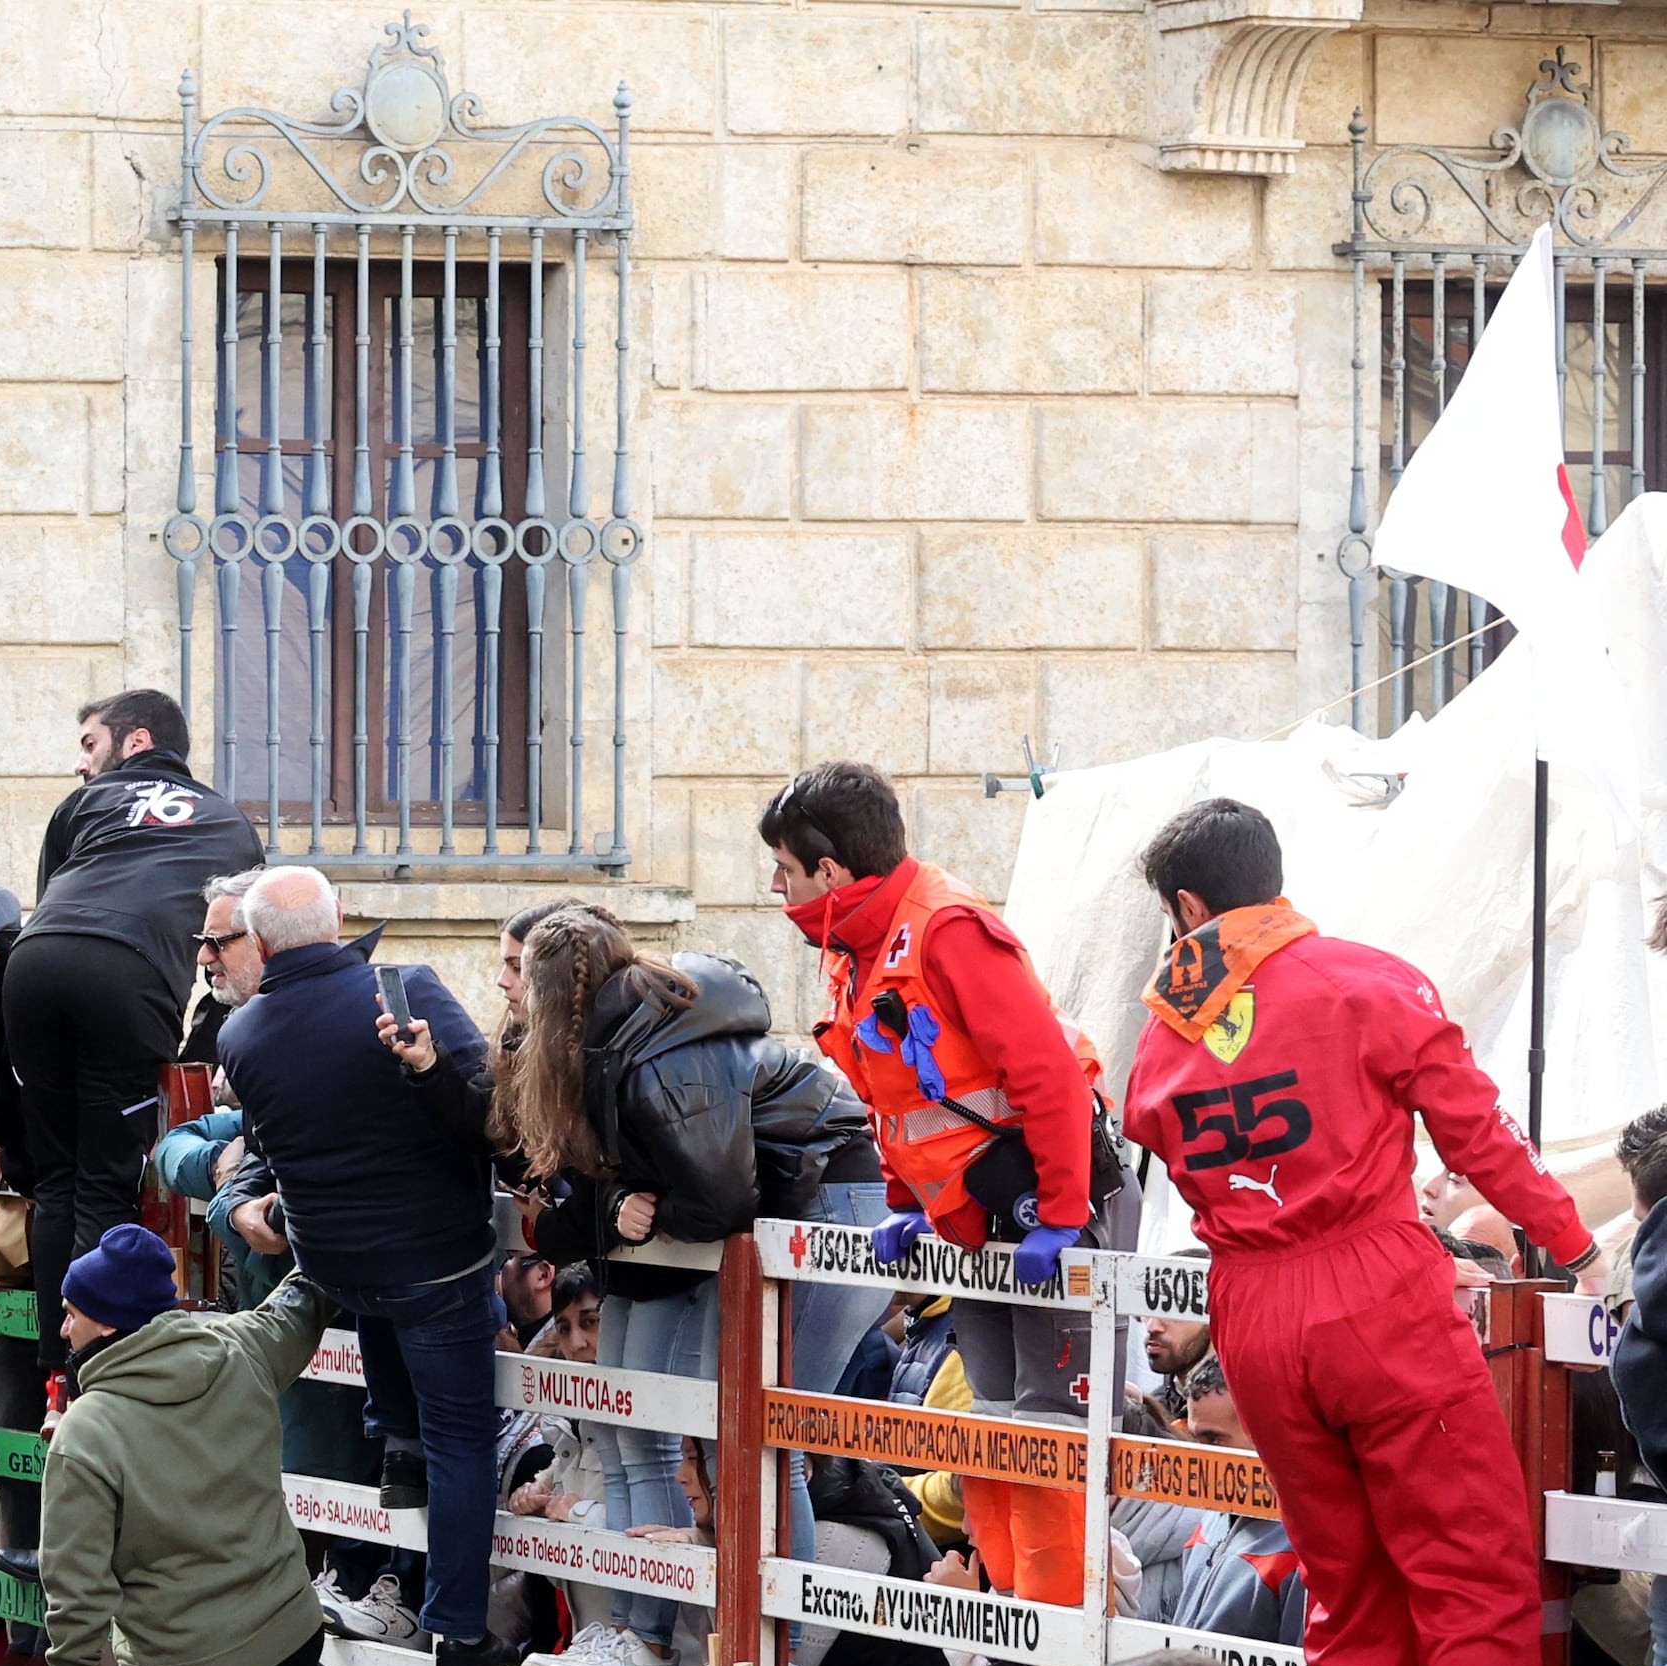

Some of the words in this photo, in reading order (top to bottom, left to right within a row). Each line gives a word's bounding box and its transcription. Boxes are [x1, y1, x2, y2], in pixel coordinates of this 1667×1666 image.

[1171, 1069, 1313, 1172] 55
[810, 1229, 849, 1272] USO
[958, 1251, 1011, 1294] CRUZ
[1144, 1265, 1189, 1314] USO
[1191, 1270, 1210, 1316] E
[538, 1370, 633, 1417] MULTICIA.es
[8, 1440, 45, 1477] GES
[768, 1402, 841, 1448] PROHIBIDA
[844, 1411, 861, 1451] LA
[865, 1415, 970, 1466] PARTICIPACIÓN
[972, 1429, 984, 1468] A
[987, 1430, 1058, 1479] MENORES
[1066, 1442, 1087, 1483] DE
[1117, 1448, 1133, 1489] 18
[1187, 1457, 1209, 1500] EN
[1213, 1462, 1247, 1505] LOS
[1251, 1466, 1278, 1510] ES
[295, 1493, 321, 1523] Bajo
[326, 1498, 392, 1535] SALAMANCA
[516, 1533, 530, 1554] de
[531, 1536, 569, 1565] Toledo
[570, 1544, 584, 1568] 26
[592, 1549, 637, 1579] CIUDAD
[640, 1557, 695, 1591] RODRIGO
[801, 1573, 869, 1623] Excmo.
[872, 1586, 1040, 1651] AYUNTAMIENTO
